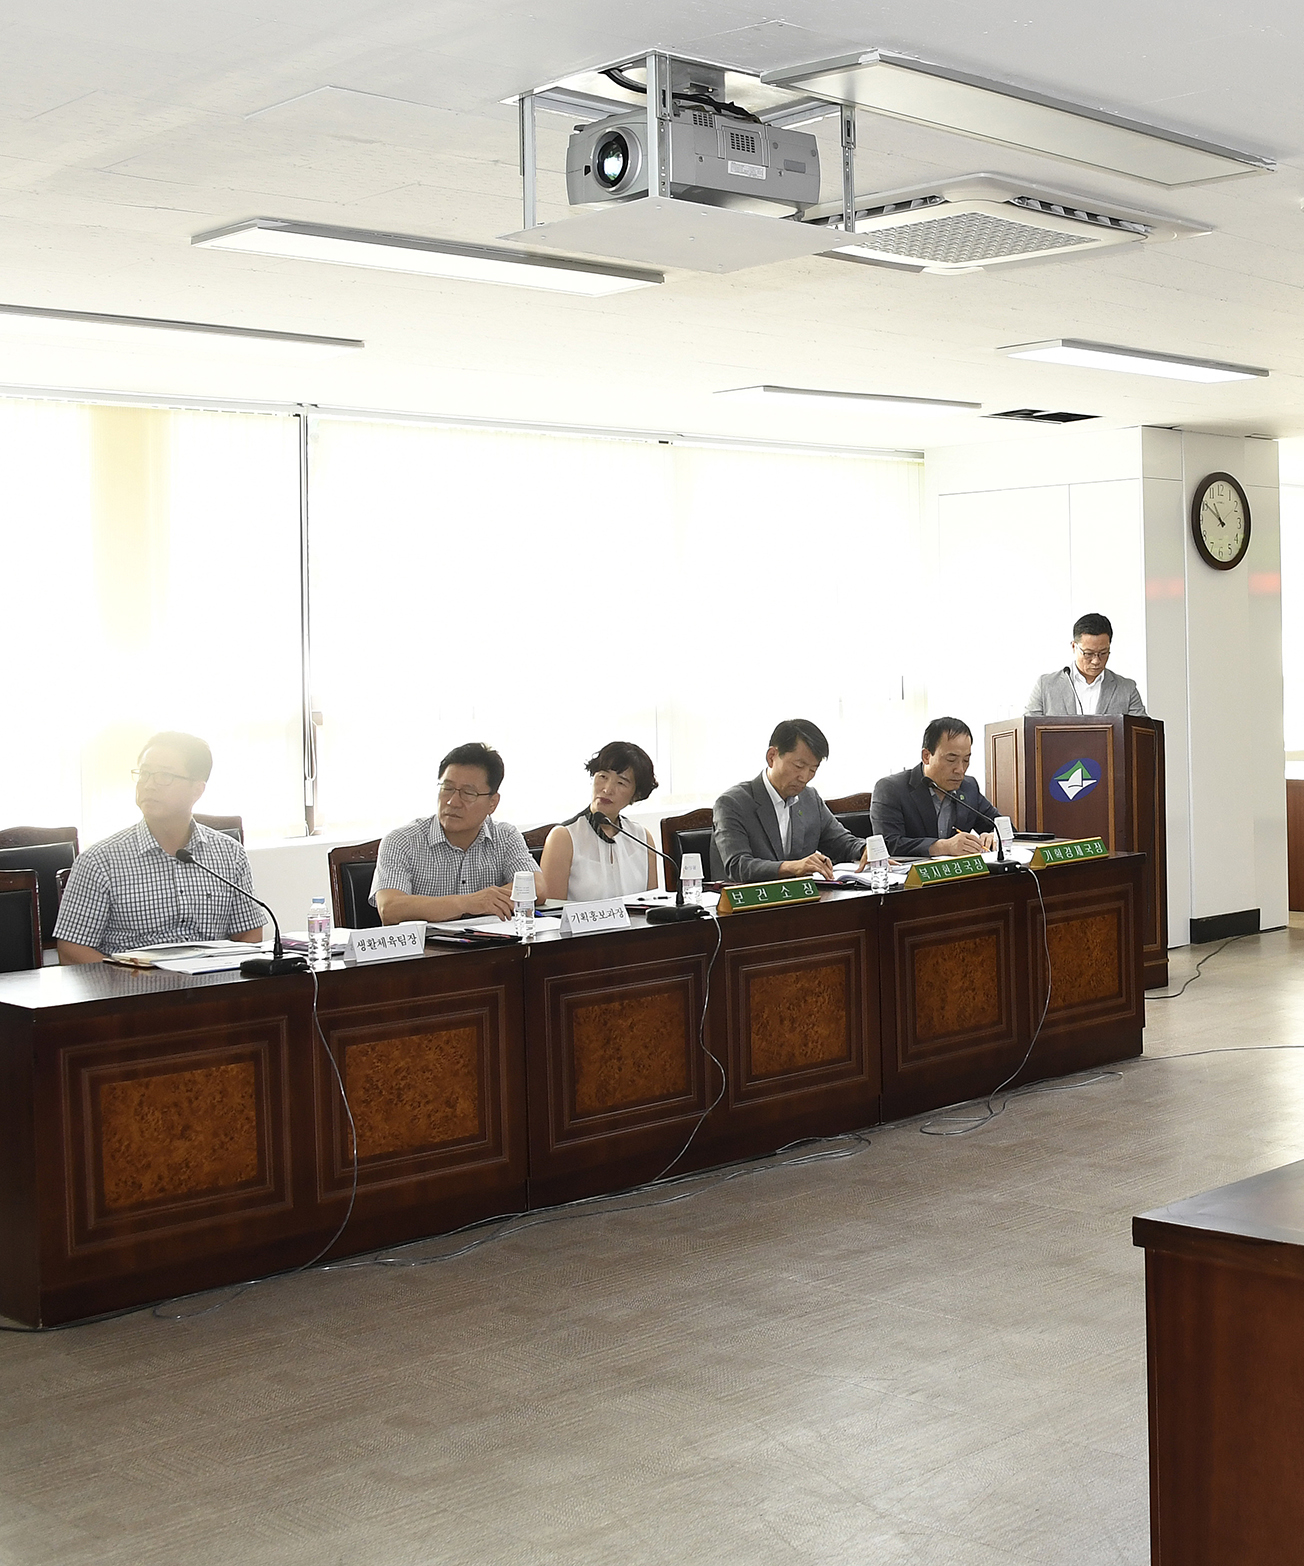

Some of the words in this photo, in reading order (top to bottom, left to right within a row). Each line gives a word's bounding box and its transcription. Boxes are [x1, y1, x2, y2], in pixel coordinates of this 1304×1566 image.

[1209, 487, 1215, 499] 11
[1217, 484, 1224, 497] 12
[1233, 500, 1238, 512] 2
[1043, 841, 1103, 861] 기획경제국장
[919, 858, 984, 879] 복지환경국장
[570, 907, 624, 924] 기획홍보과장
[356, 932, 417, 952] 생활체육팀장
